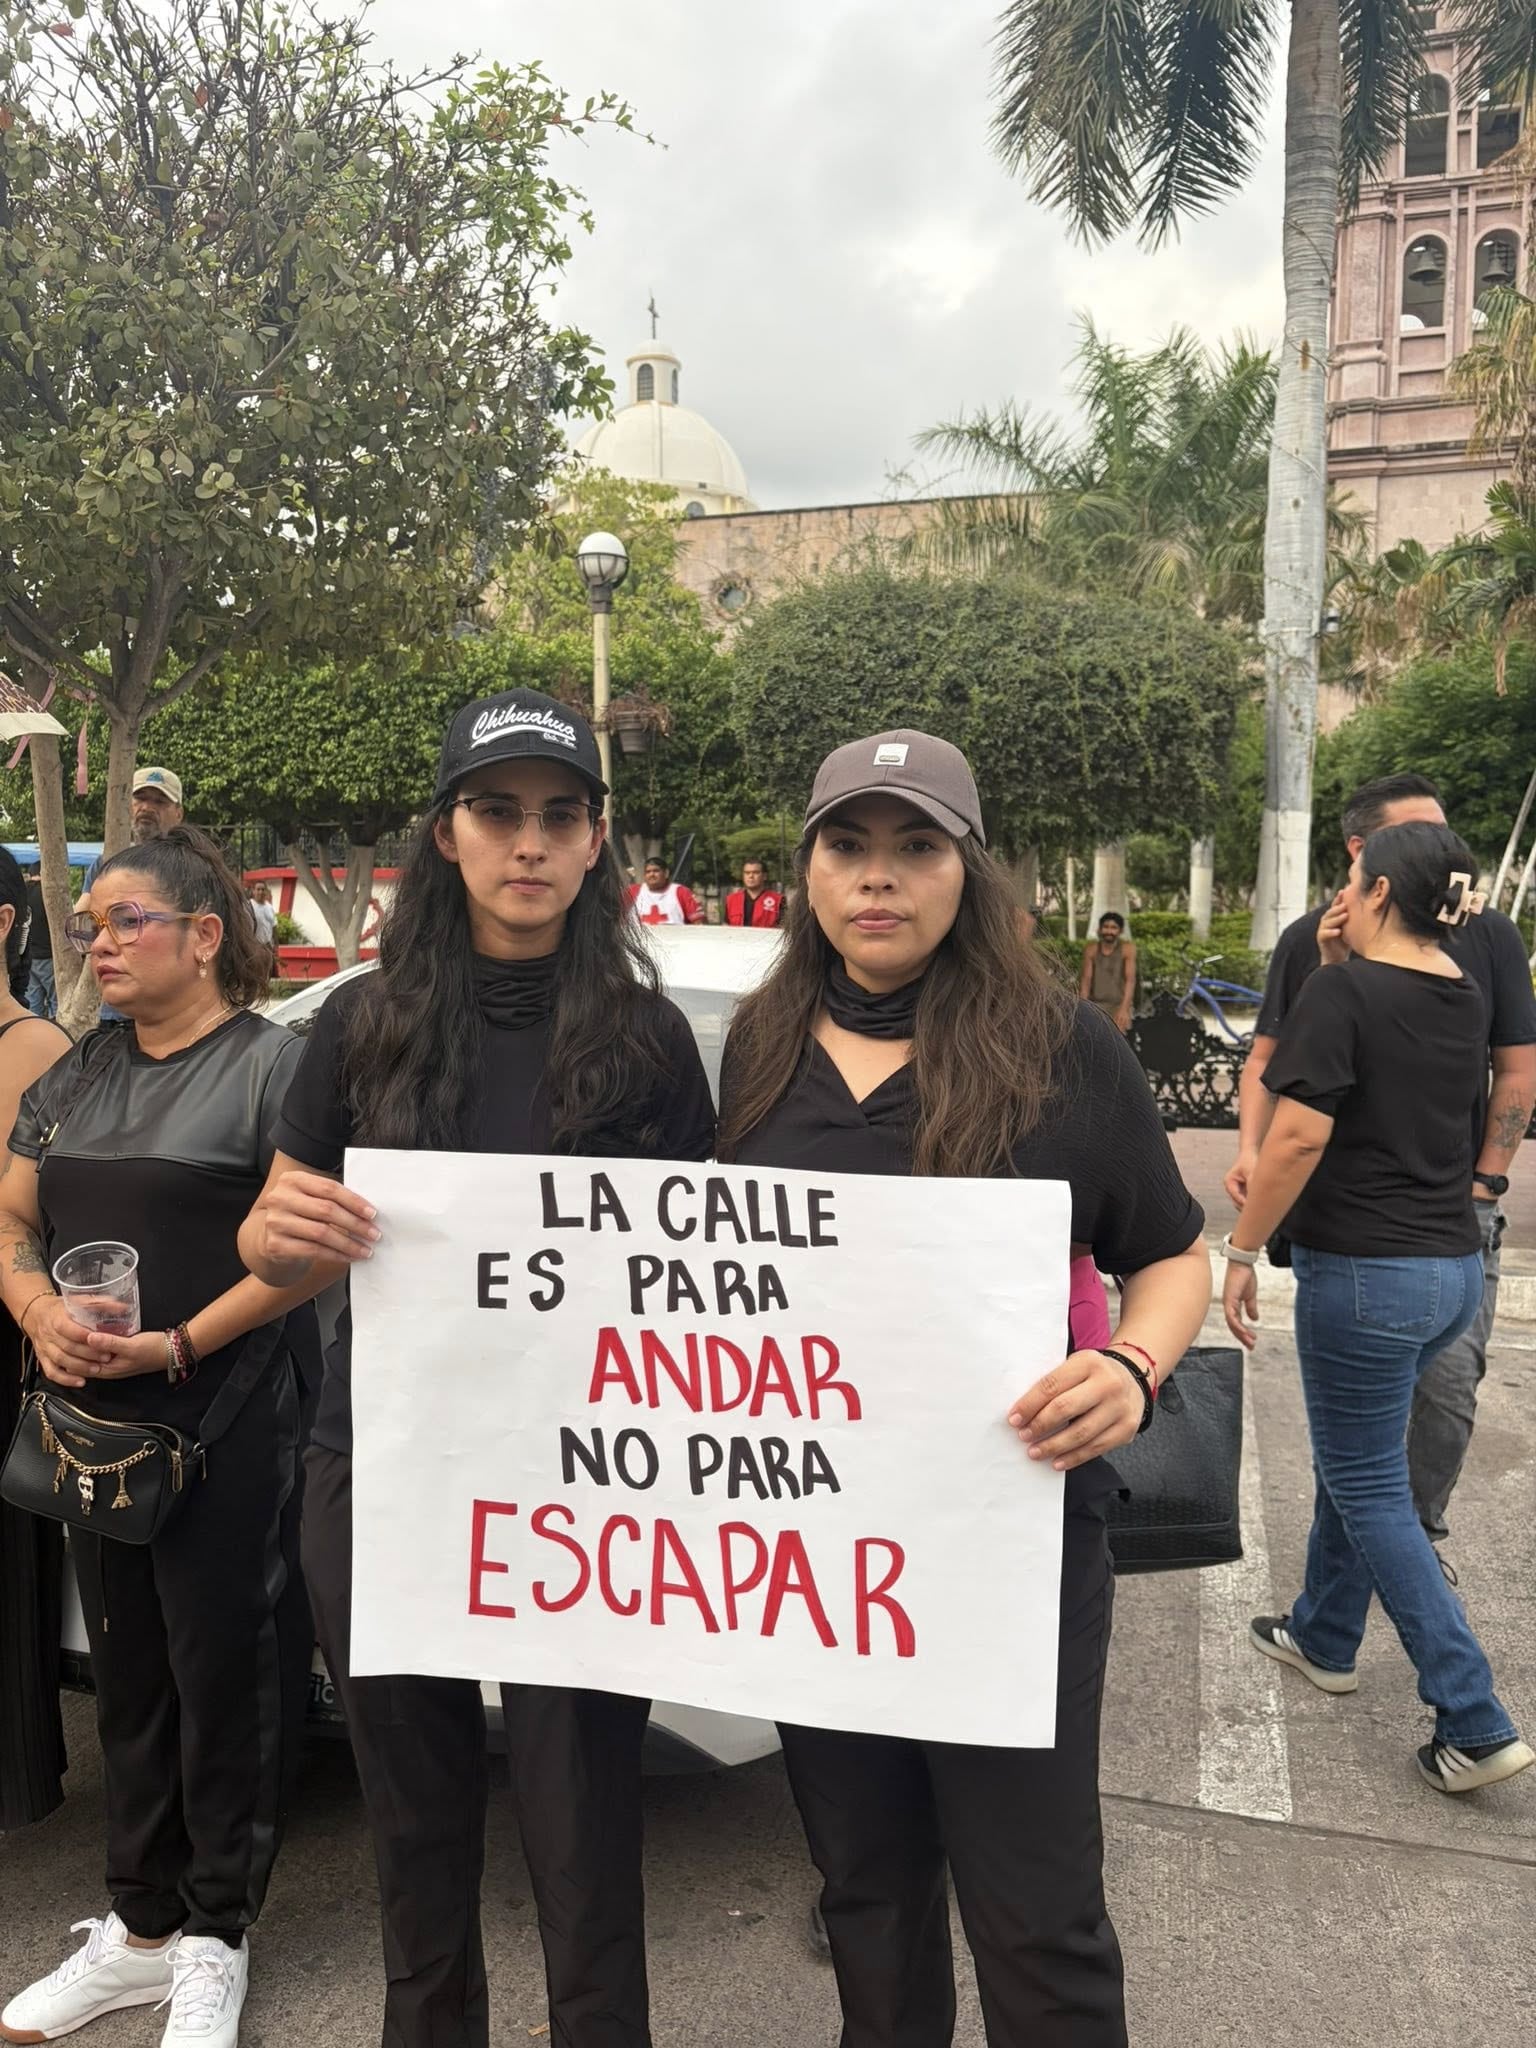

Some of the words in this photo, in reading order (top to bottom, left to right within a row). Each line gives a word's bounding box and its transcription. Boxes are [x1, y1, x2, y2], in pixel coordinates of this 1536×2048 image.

[472, 703, 577, 741] Chihuahua
[539, 1171, 632, 1234] LA
[657, 1174, 840, 1250] CALLE
[477, 1248, 566, 1313] ES
[626, 1253, 790, 1317] PARA
[587, 1326, 863, 1422] ANDAR
[559, 1426, 660, 1491] NO
[687, 1433, 843, 1501] PARA
[467, 1498, 917, 1659] ESCAPAR
